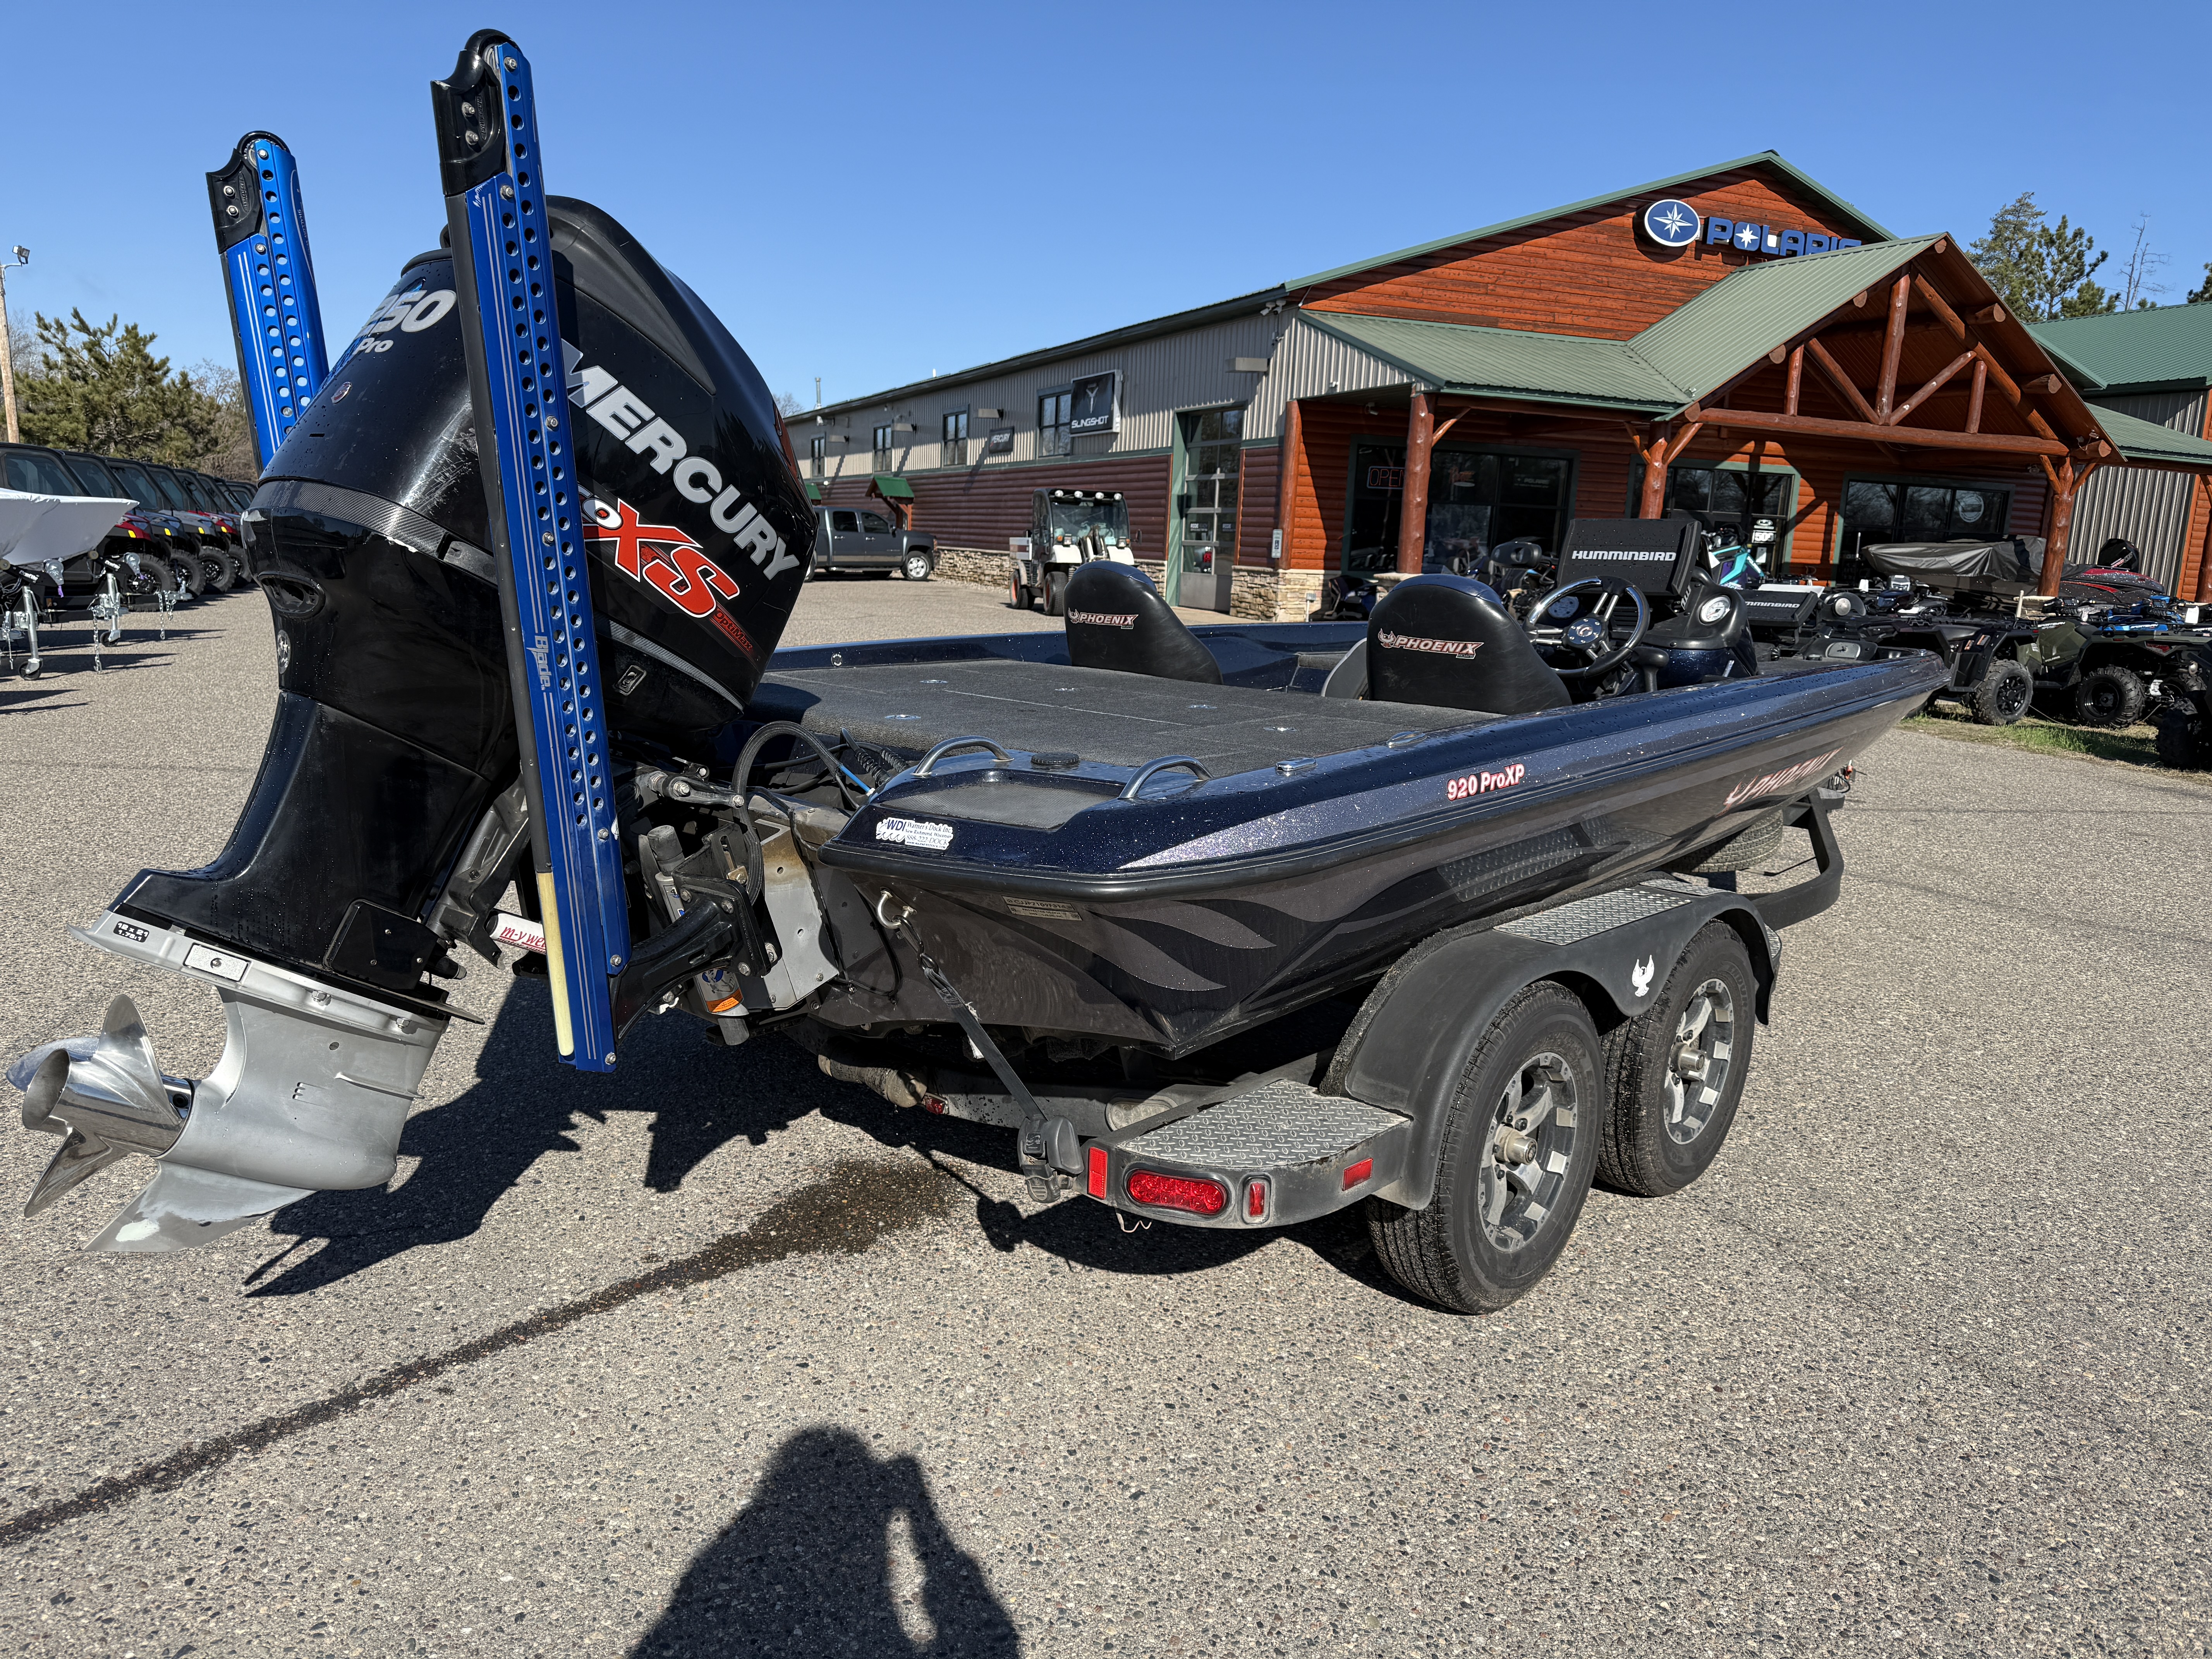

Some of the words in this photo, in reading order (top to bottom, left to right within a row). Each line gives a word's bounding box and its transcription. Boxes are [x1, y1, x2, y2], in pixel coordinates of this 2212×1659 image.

[349, 337, 394, 359] Pro
[1071, 415, 1109, 429] SLINGSHOT
[1571, 550, 1676, 561] HUMMINBIRD
[1079, 613, 1138, 625] PHOENIX
[714, 610, 753, 651] OptiMax
[1394, 635, 1484, 655] PHOENIX
[526, 635, 552, 687] Blade
[1447, 775, 1477, 800] 920
[1480, 763, 1525, 793] ProXP
[886, 819, 907, 831] WDI
[907, 821, 927, 830] Warner's
[906, 834, 948, 845] 888-222-DOCK
[136, 929, 148, 937] 21
